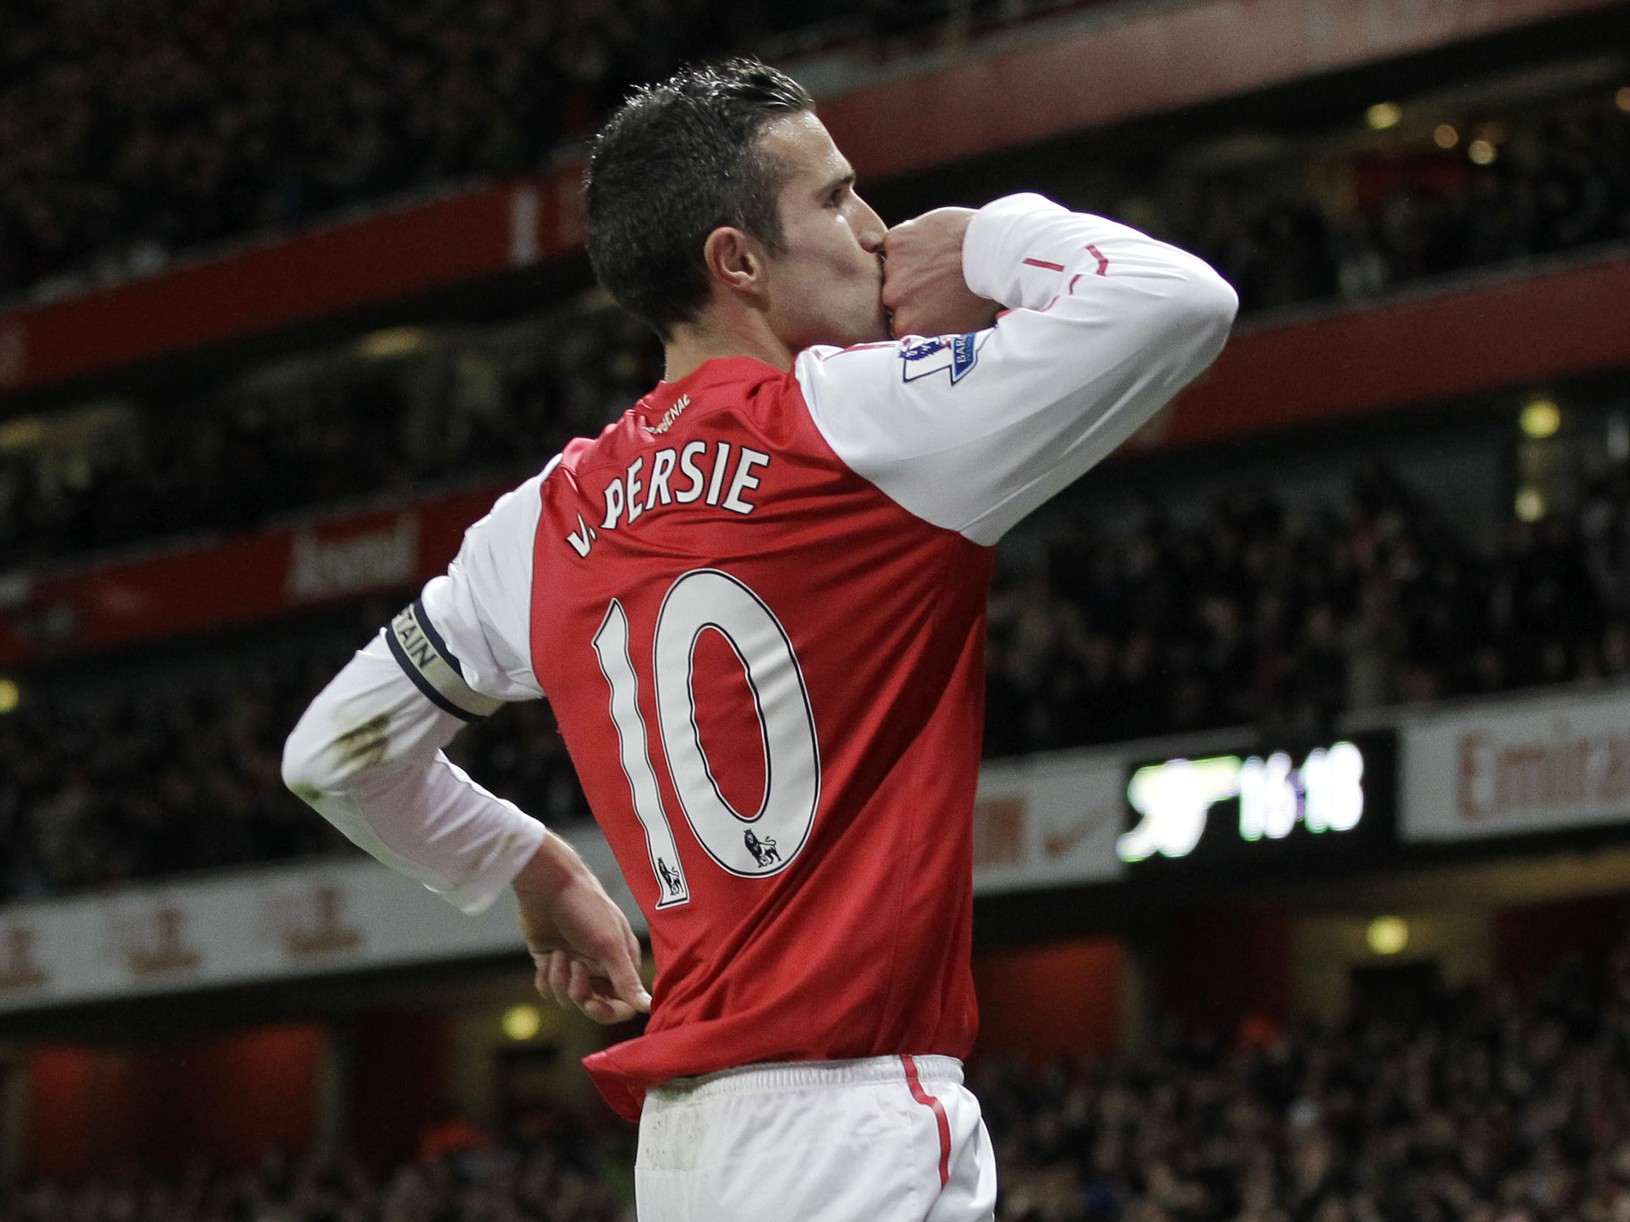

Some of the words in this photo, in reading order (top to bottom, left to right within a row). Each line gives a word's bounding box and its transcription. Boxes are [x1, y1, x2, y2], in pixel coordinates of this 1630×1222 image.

[600, 440, 770, 530] PERSIE
[396, 607, 438, 669] TAIN
[591, 568, 821, 910] 10
